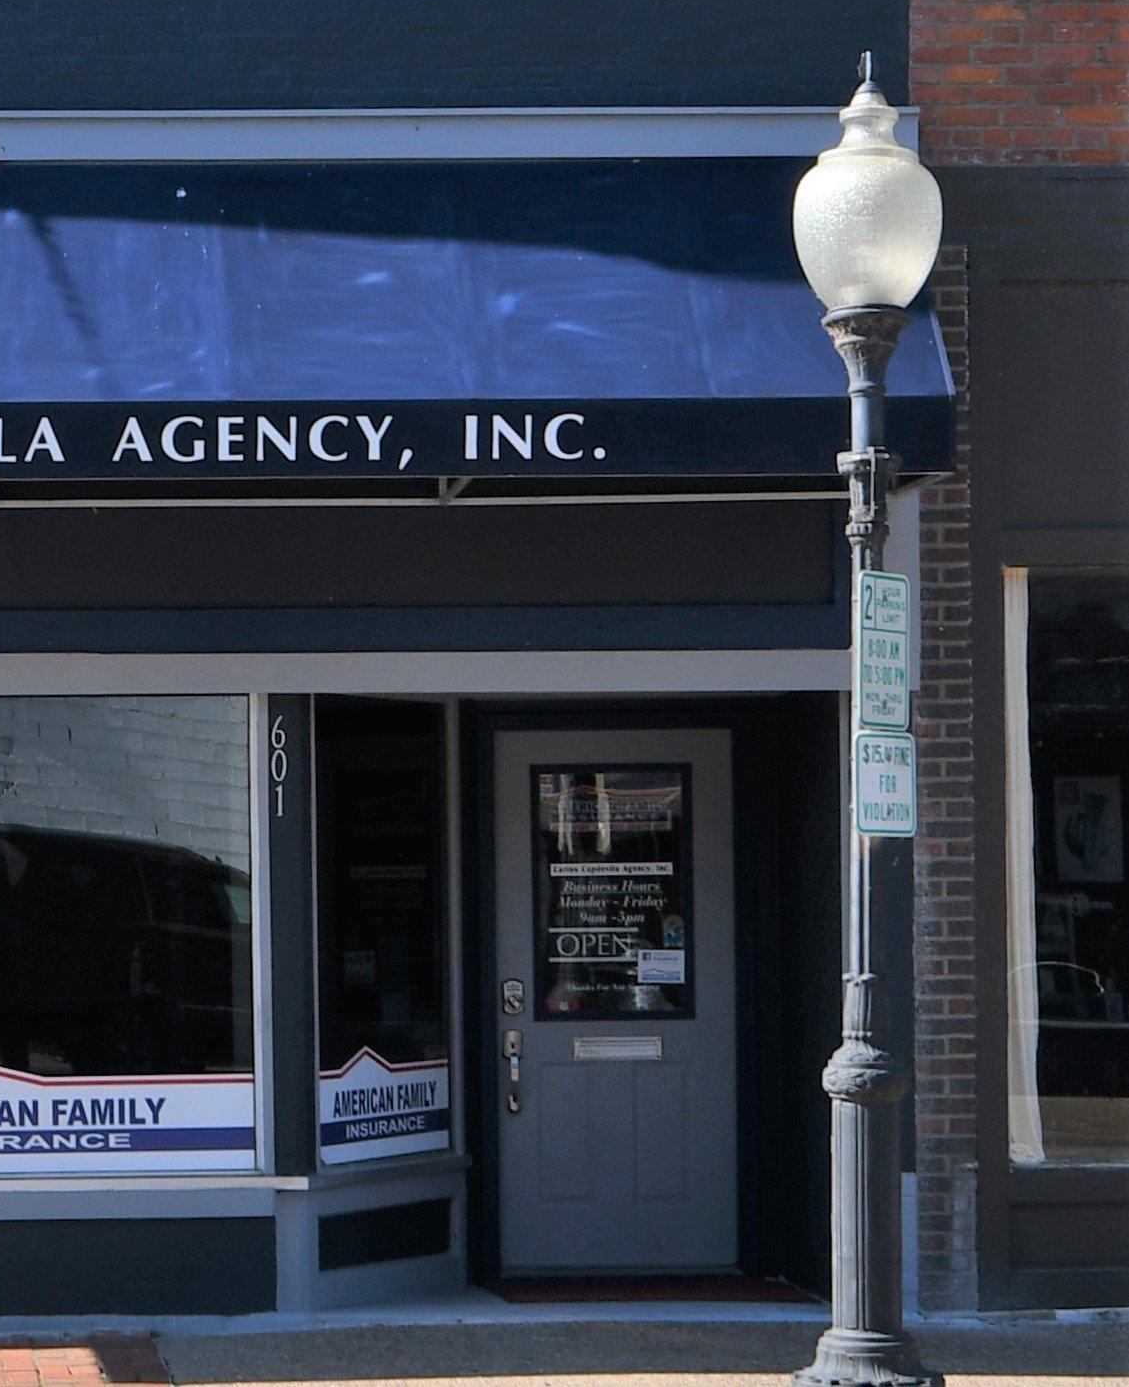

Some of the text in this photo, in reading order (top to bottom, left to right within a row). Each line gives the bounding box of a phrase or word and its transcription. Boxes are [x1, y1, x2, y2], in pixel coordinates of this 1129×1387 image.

[111, 414, 414, 471] AGENCY,
[464, 412, 607, 461] INC.
[864, 584, 873, 620] 2
[890, 641, 900, 661] AM
[863, 664, 872, 684] TO
[894, 667, 906, 688] PM
[271, 714, 288, 818] 601
[893, 746, 911, 767] FINE
[879, 773, 897, 794] FOR
[862, 801, 911, 821] VIOLATION
[564, 879, 661, 894] Business Hours
[560, 895, 609, 911] Monday
[623, 895, 667, 911] Friday
[556, 933, 633, 956] OPEN
[51, 1097, 166, 1126] FAMILY
[333, 1081, 437, 1119] AMERICAN FAMILY
[344, 1117, 426, 1140] INSURANCE
